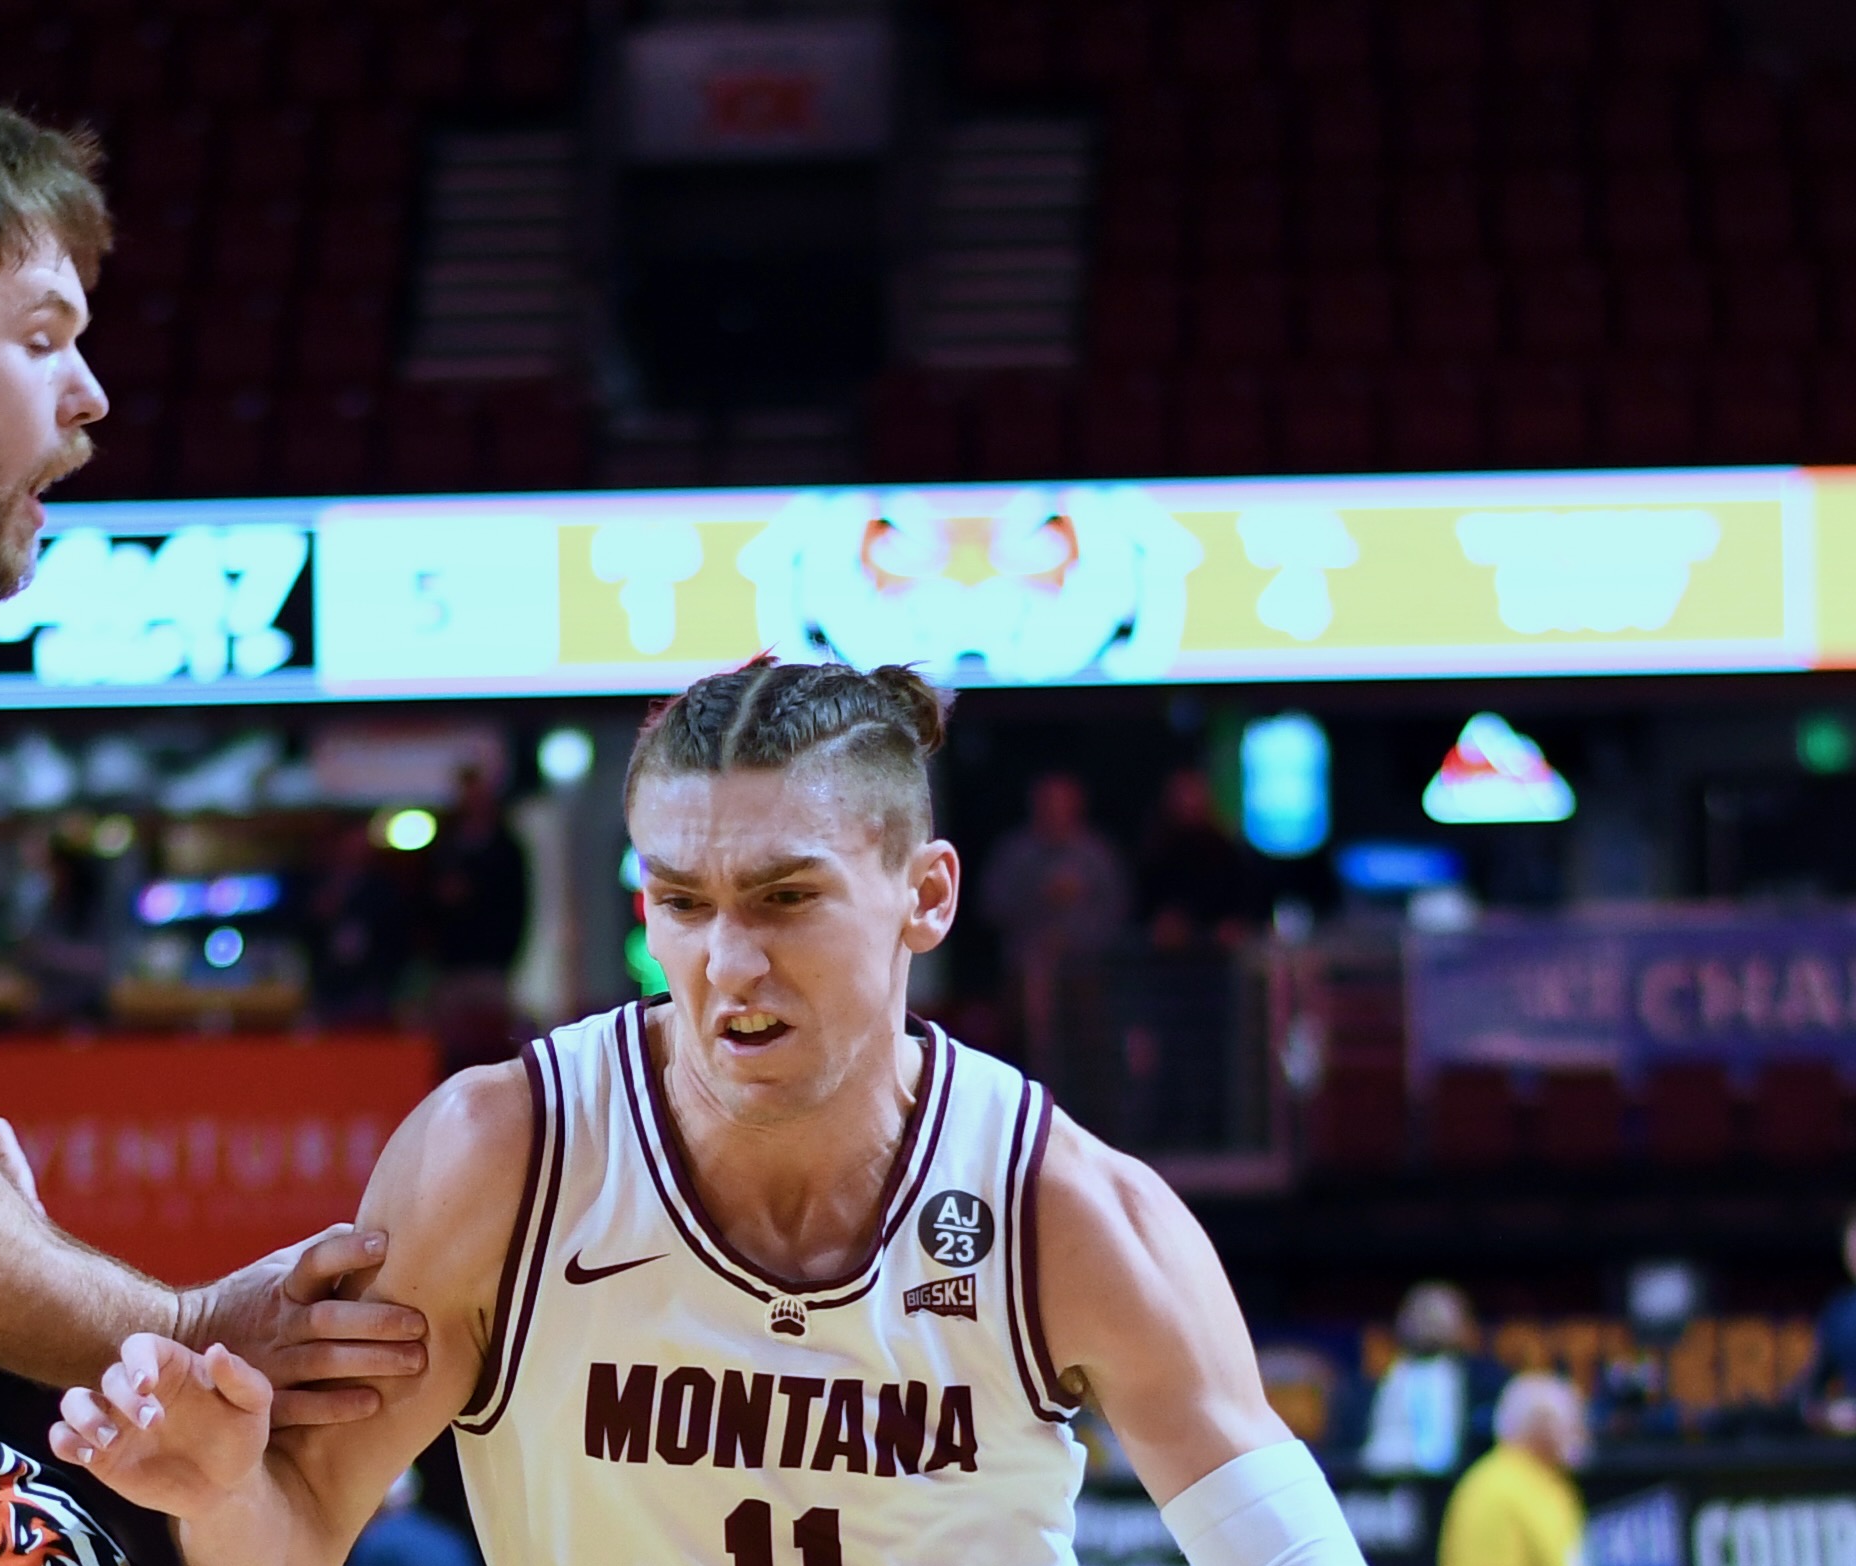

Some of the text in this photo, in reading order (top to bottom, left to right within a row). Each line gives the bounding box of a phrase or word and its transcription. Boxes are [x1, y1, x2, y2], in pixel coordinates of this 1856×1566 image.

[937, 1196, 980, 1228] AJ
[933, 1231, 976, 1263] 23
[583, 1361, 979, 1479] MONTANA
